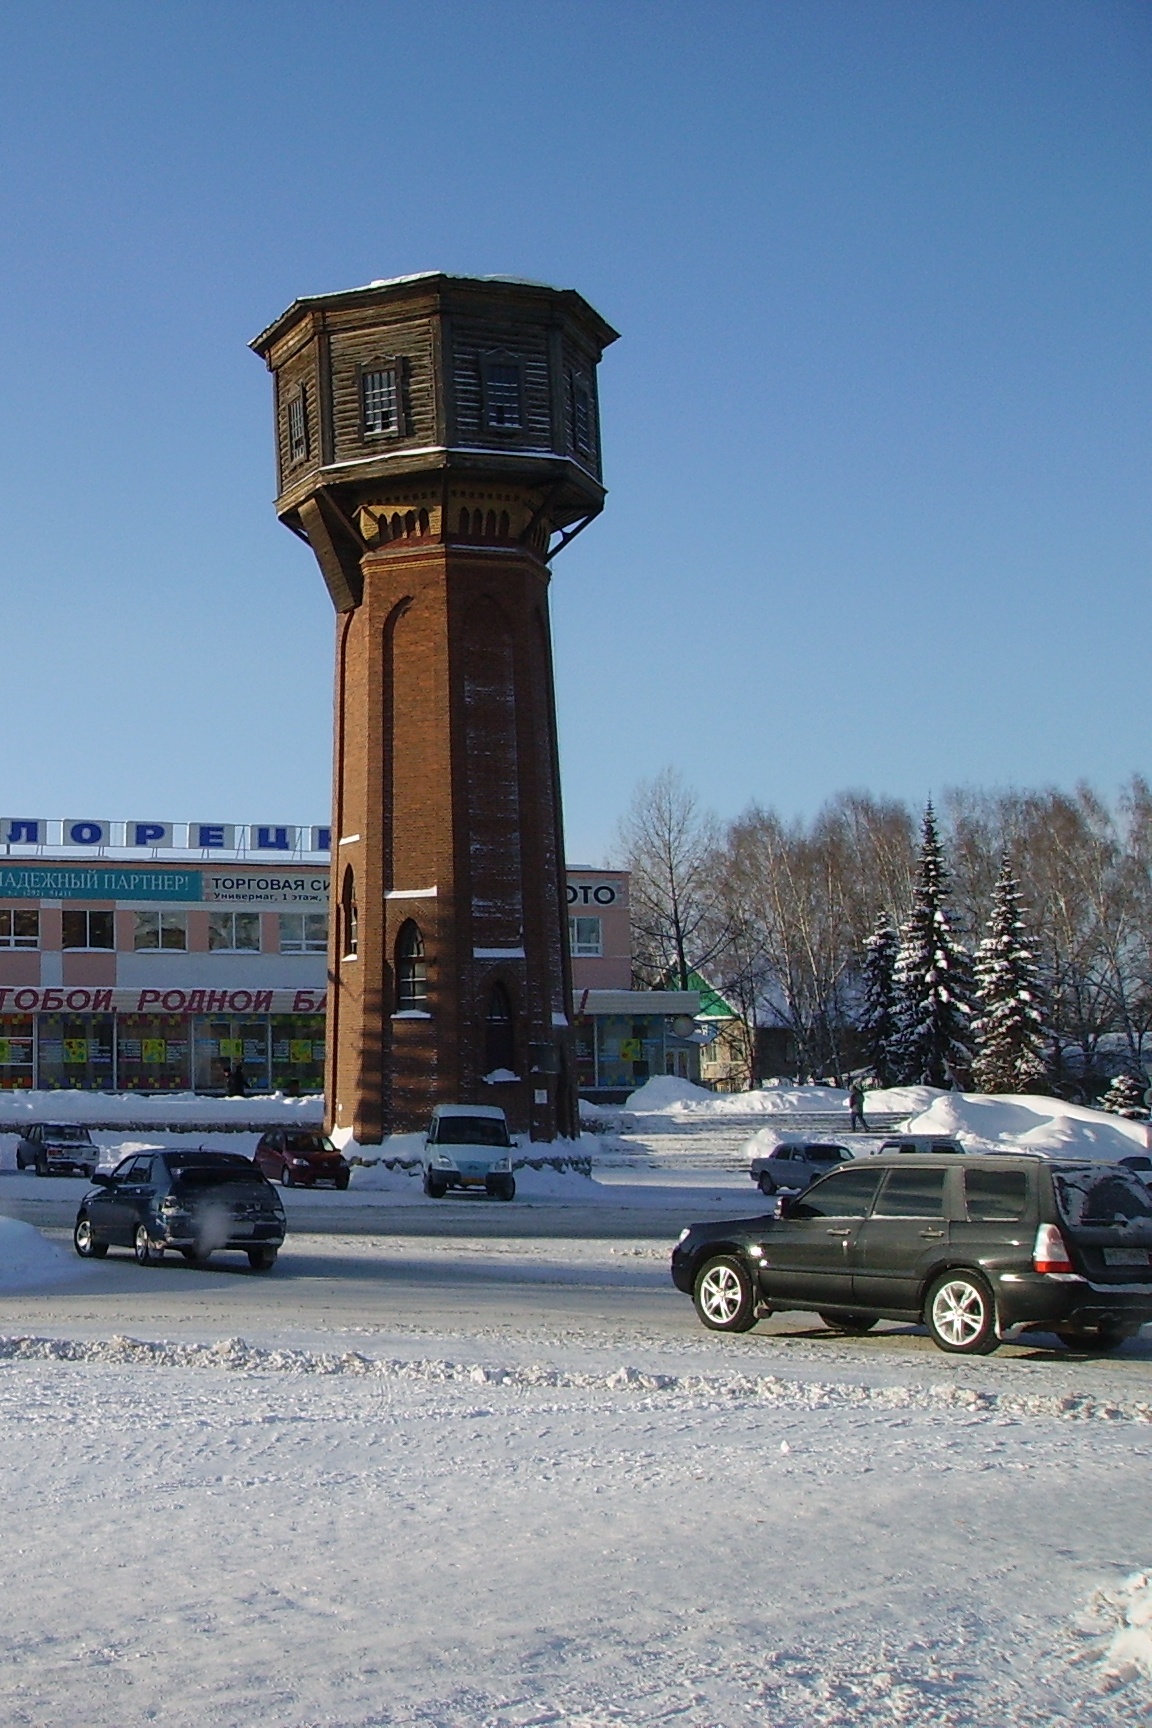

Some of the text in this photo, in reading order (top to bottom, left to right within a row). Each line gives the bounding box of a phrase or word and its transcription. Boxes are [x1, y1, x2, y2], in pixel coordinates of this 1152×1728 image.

[104, 873, 189, 891] ПАРТНЕР!
[212, 877, 305, 891] ТОРГОВАЯ
[214, 892, 322, 902] Универмаг, 1 этаж,
[137, 989, 274, 1013] РОДНОЙ
